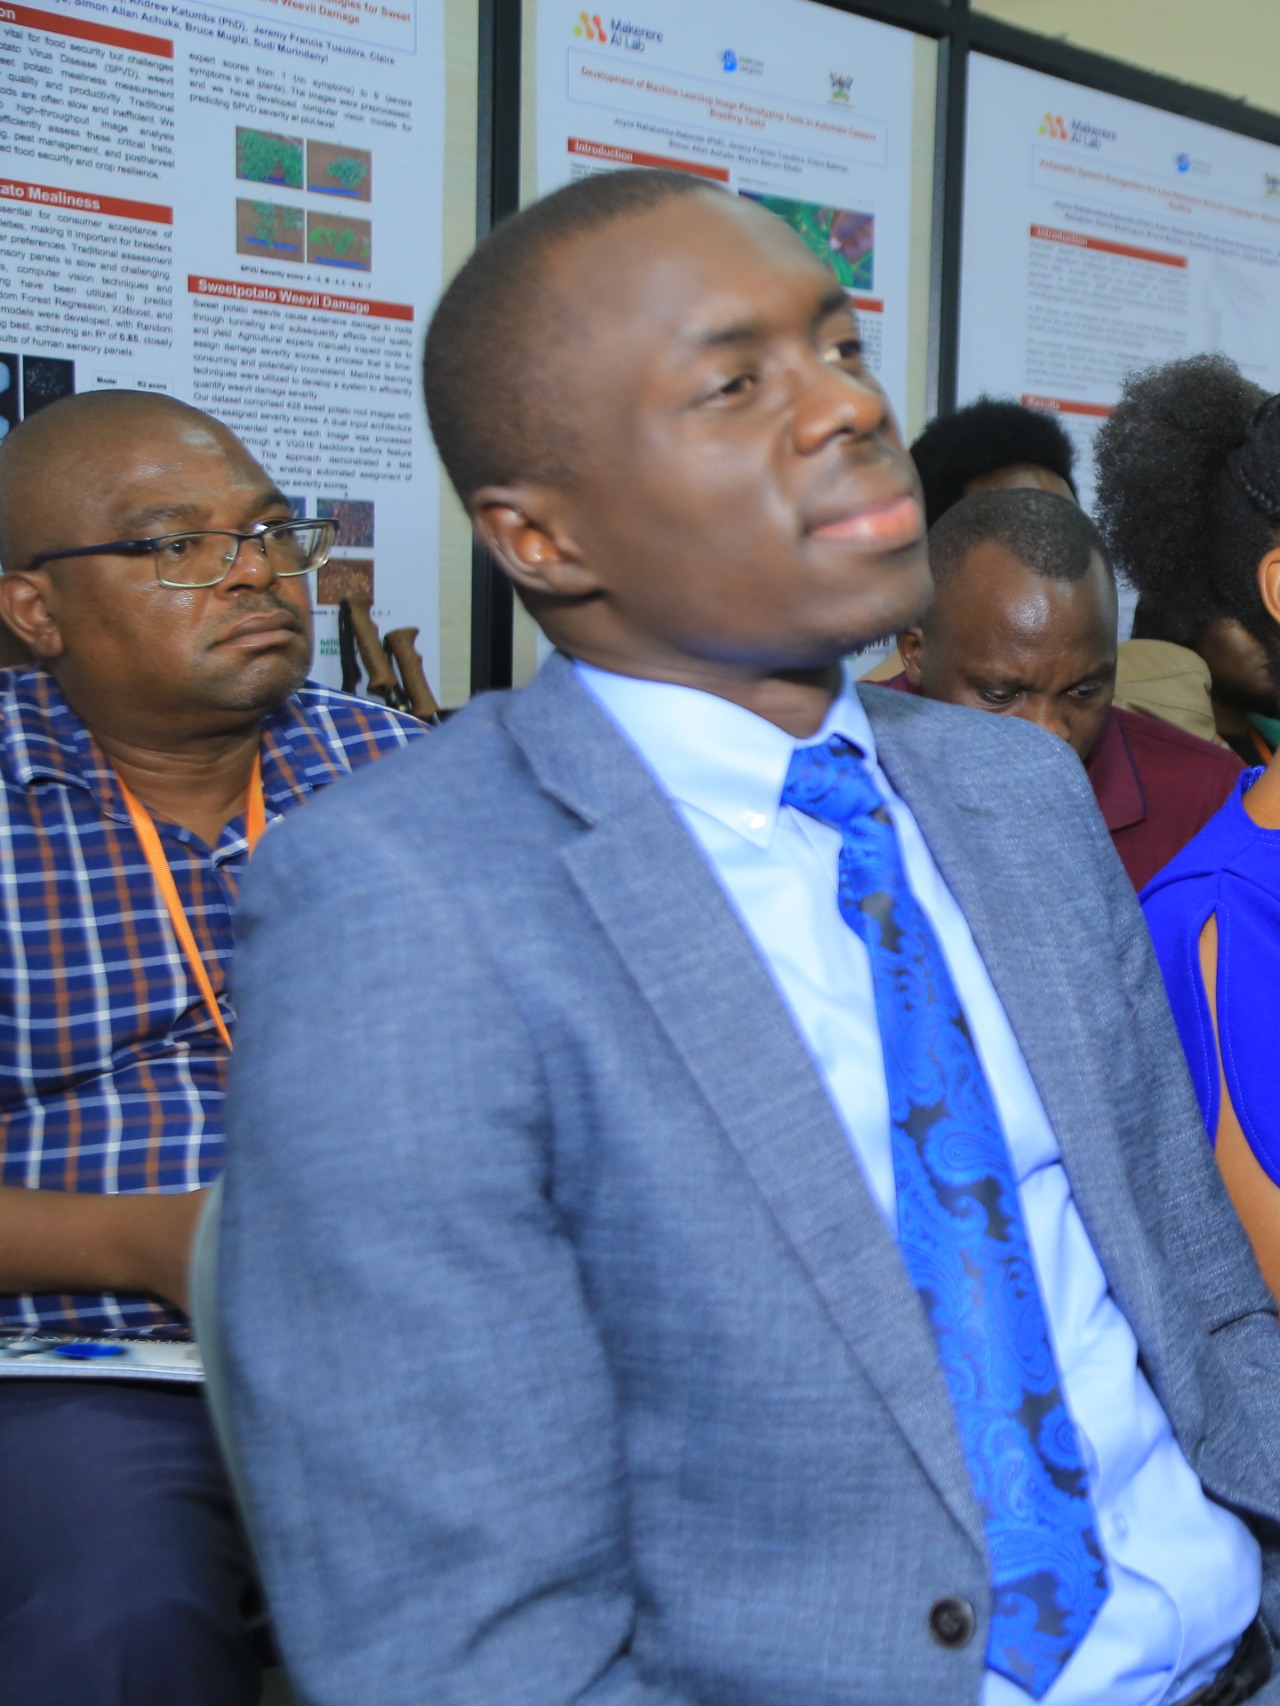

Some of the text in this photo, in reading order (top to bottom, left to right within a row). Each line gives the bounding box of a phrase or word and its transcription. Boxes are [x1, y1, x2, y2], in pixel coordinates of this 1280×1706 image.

[281, 0, 317, 14] Weevil
[319, 6, 361, 25] Damage
[611, 18, 664, 42] Makerere
[611, 33, 645, 51] AI Lab
[4, 28, 175, 73] vital for food security but challenges
[29, 47, 54, 60] Virus
[60, 53, 98, 70] Disease
[147, 74, 175, 86] weevil
[581, 66, 635, 87] Development
[7, 74, 40, 88] quality
[45, 81, 64, 91] and
[130, 96, 175, 113] Traditional
[23, 63, 175, 100] potato mealiness measurement
[16, 102, 176, 142] high-throughput image analysis
[21, 92, 38, 101] are
[40, 94, 65, 106] often
[67, 99, 89, 111] slow
[92, 105, 110, 115] and
[160, 116, 175, 127] We
[48, 125, 81, 138] assess
[86, 130, 112, 143] these
[117, 137, 146, 150] critical
[1071, 120, 1117, 141] Makerere
[13, 145, 36, 157] food
[37, 152, 74, 166] security
[75, 158, 94, 168] and
[95, 162, 116, 174] crop
[14, 133, 36, 143] pest
[104, 150, 123, 159] and
[125, 154, 176, 169] postharvest
[575, 140, 634, 161] Introduction
[27, 186, 101, 211] Mealiness
[38, 210, 173, 239] for consumer acceptance of
[30, 225, 173, 252] making it important for breeders
[29, 253, 61, 264] panels
[64, 256, 73, 265] is
[76, 258, 97, 269] slow
[100, 262, 118, 272] and
[73, 243, 119, 258] Traditional
[121, 253, 173, 266] assessment
[17, 267, 173, 294] computer vision techniques and
[21, 279, 174, 307] have been utilized to predict
[21, 293, 52, 305] Forest
[156, 311, 174, 321] and
[199, 278, 370, 314] Sweetpotato Weevil Damage
[0, 306, 36, 317] models
[37, 312, 61, 320] were
[116, 319, 134, 329] with
[137, 321, 174, 334] Random
[21, 336, 31, 345] of
[32, 336, 65, 349] human
[66, 343, 102, 355] sensory
[35, 324, 80, 338] achieving
[109, 331, 118, 340] of
[144, 335, 173, 349] closely
